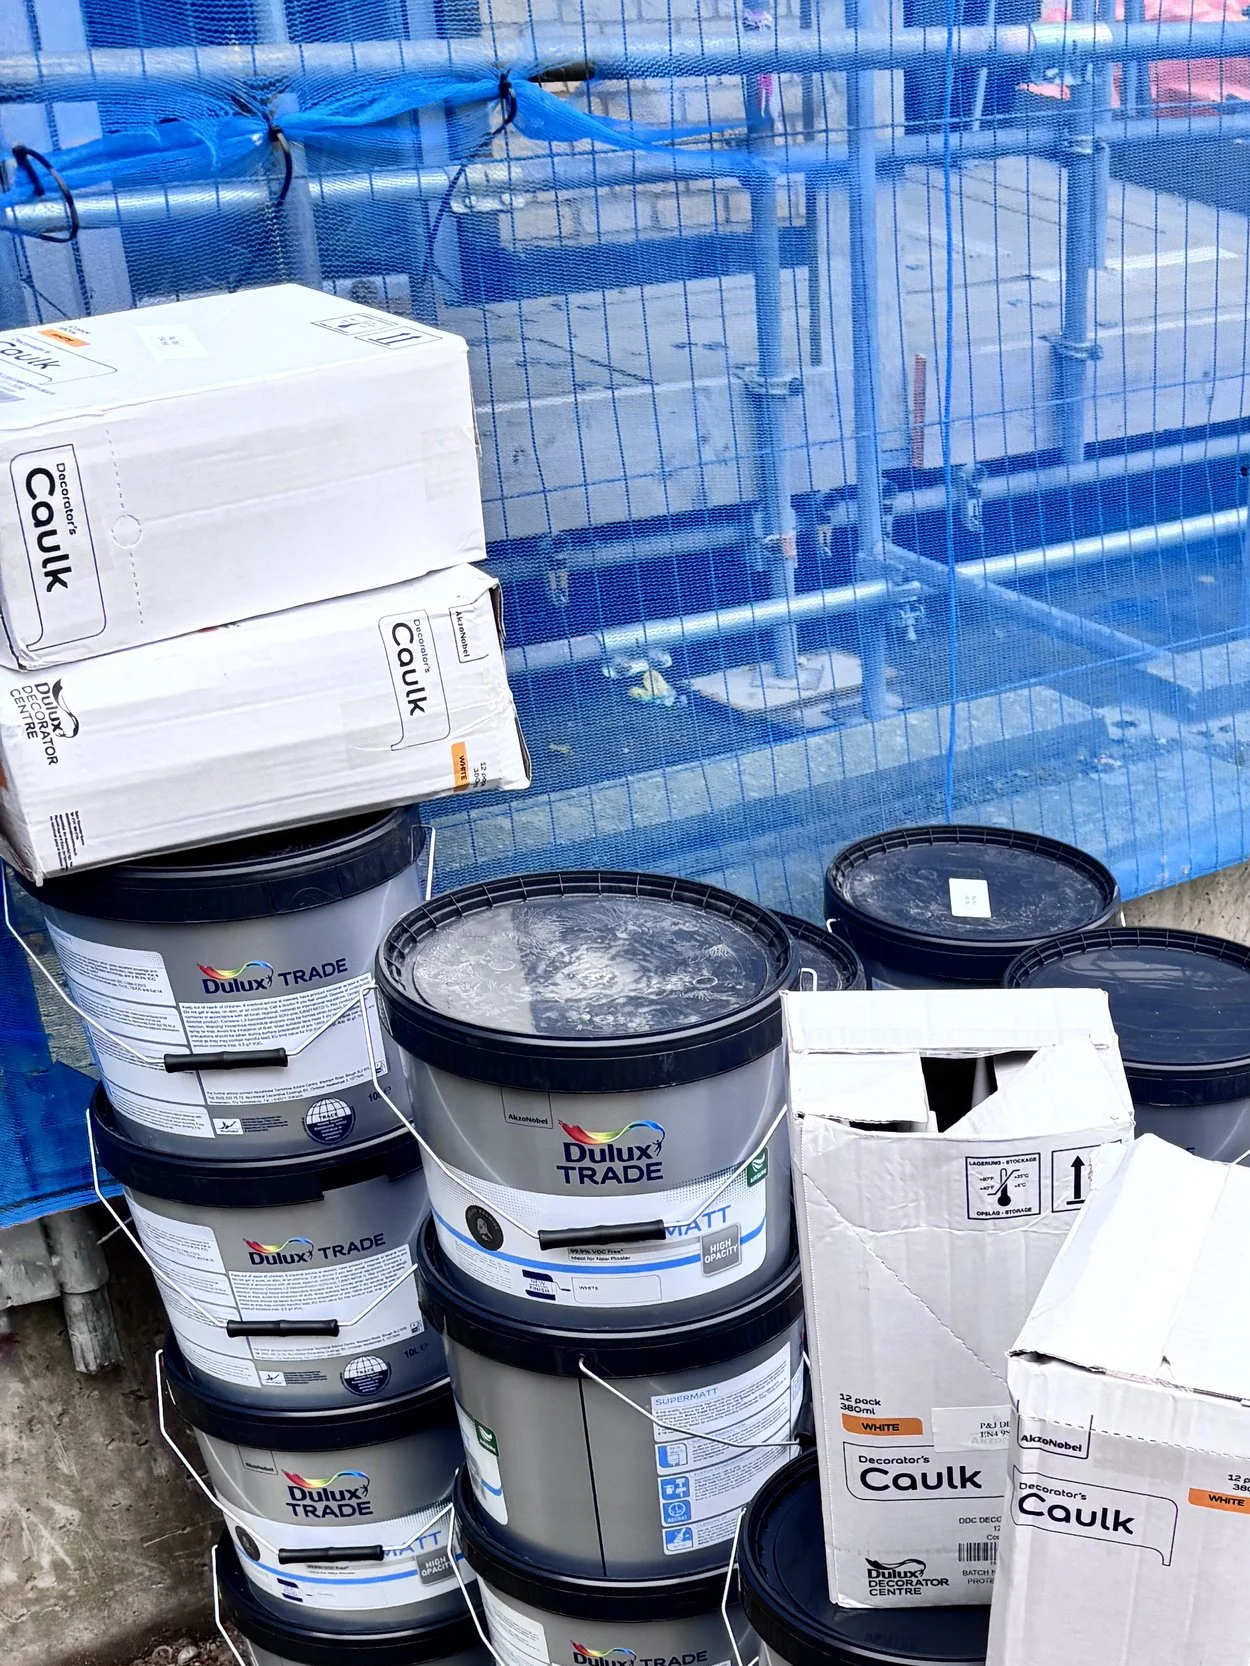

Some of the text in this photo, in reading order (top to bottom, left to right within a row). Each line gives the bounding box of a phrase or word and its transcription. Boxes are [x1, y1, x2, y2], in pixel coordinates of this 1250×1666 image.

[56, 462, 78, 536] Decorator's
[25, 467, 72, 593] Caulk
[455, 610, 471, 658] AkzoNobel
[413, 618, 431, 674] Decorator's
[391, 621, 428, 717] Caulk
[10, 688, 39, 740] CENTRE
[34, 681, 63, 734] Dulux
[21, 685, 59, 766] DECORATOR
[458, 755, 469, 781] WHITE
[202, 957, 348, 995] Dulux TRADE
[507, 1112, 549, 1126] AkzoNobel
[562, 1141, 653, 1165] Dulux
[1006, 1157, 1037, 1166] STOCKAGE
[556, 1161, 664, 1186] TRADE
[1005, 1207, 1032, 1215] STORAGE
[248, 1232, 386, 1267] Dulux TRADE
[710, 1236, 732, 1253] HIGH
[704, 1244, 739, 1265] OPACITY
[655, 1387, 719, 1406] SUPERMATT
[839, 1393, 882, 1407] 12 pack
[839, 1403, 876, 1415] 380ml
[861, 1422, 900, 1432] WHITE
[979, 1421, 997, 1430] P&J
[1020, 1434, 1083, 1453] AkzoNobel
[858, 1455, 930, 1465] Decorator's
[859, 1465, 983, 1492] Caulk
[1227, 1474, 1244, 1483] 12
[287, 1485, 360, 1503] Dulux
[1019, 1481, 1087, 1502] Decorator's
[1208, 1494, 1246, 1508] WHITE
[286, 1501, 374, 1519] TRADE
[1018, 1492, 1135, 1536] Caulk
[424, 1555, 449, 1571] HIGH
[867, 1567, 918, 1580] Dulux
[962, 1569, 990, 1577] BATCH
[868, 1578, 950, 1588] DECORATOR
[869, 1587, 922, 1597] CENTRE
